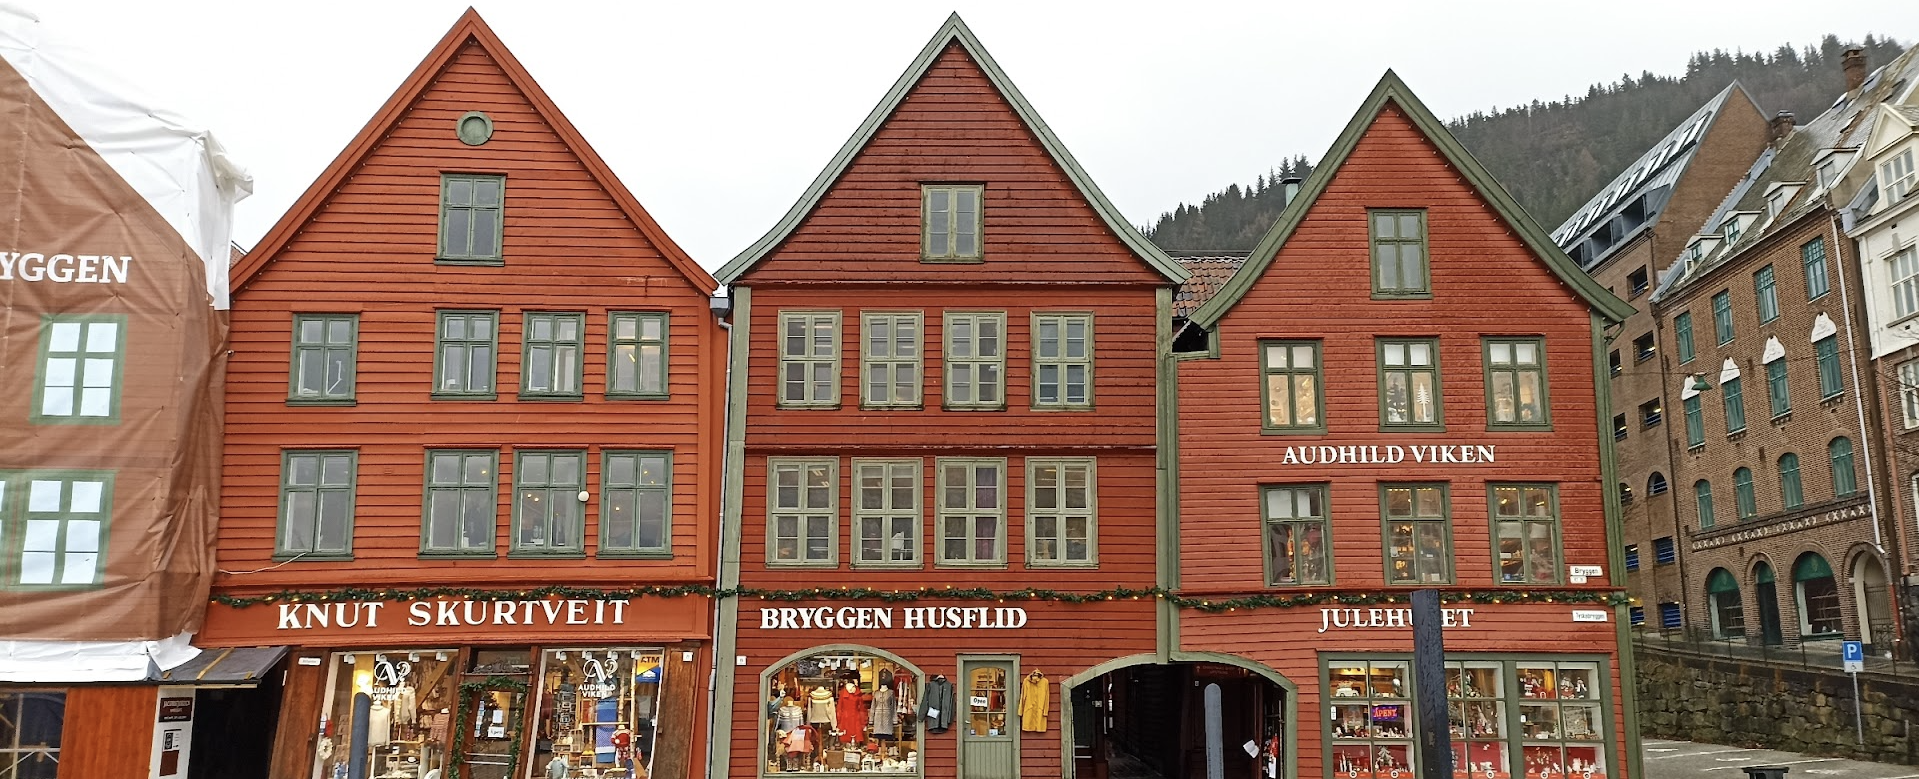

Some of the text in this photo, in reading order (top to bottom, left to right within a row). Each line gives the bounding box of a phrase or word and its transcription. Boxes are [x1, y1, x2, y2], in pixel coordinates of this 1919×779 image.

[1282, 445, 1496, 465] AUDHILD VIKEN
[1575, 567, 1598, 575] Bryggen
[277, 600, 630, 630] KNUT SKURTVEIT
[759, 606, 1028, 630] BRYGGEN HUSFLID
[1318, 607, 1475, 633] JULEHET
[641, 656, 660, 664] ATM
[1847, 644, 1857, 658] P
